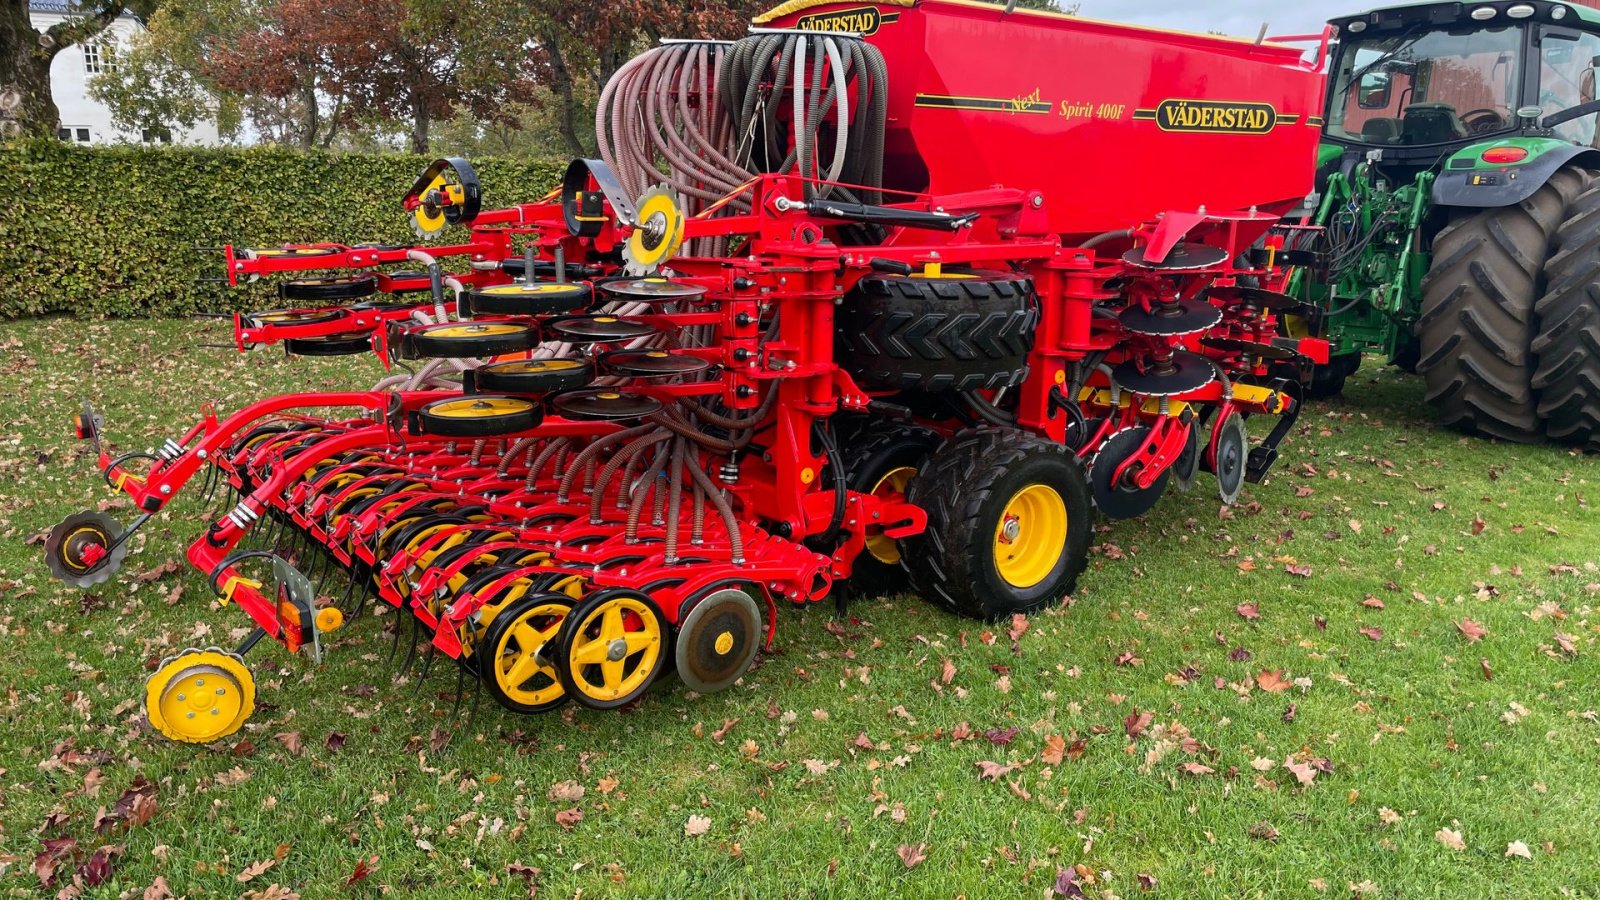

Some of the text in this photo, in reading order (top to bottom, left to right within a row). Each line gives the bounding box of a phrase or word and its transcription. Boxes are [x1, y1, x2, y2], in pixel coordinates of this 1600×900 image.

[1011, 87, 1040, 115] Next
[1059, 100, 1125, 120] Spirit 400F
[1166, 102, 1268, 129] VÄDERSTAD
